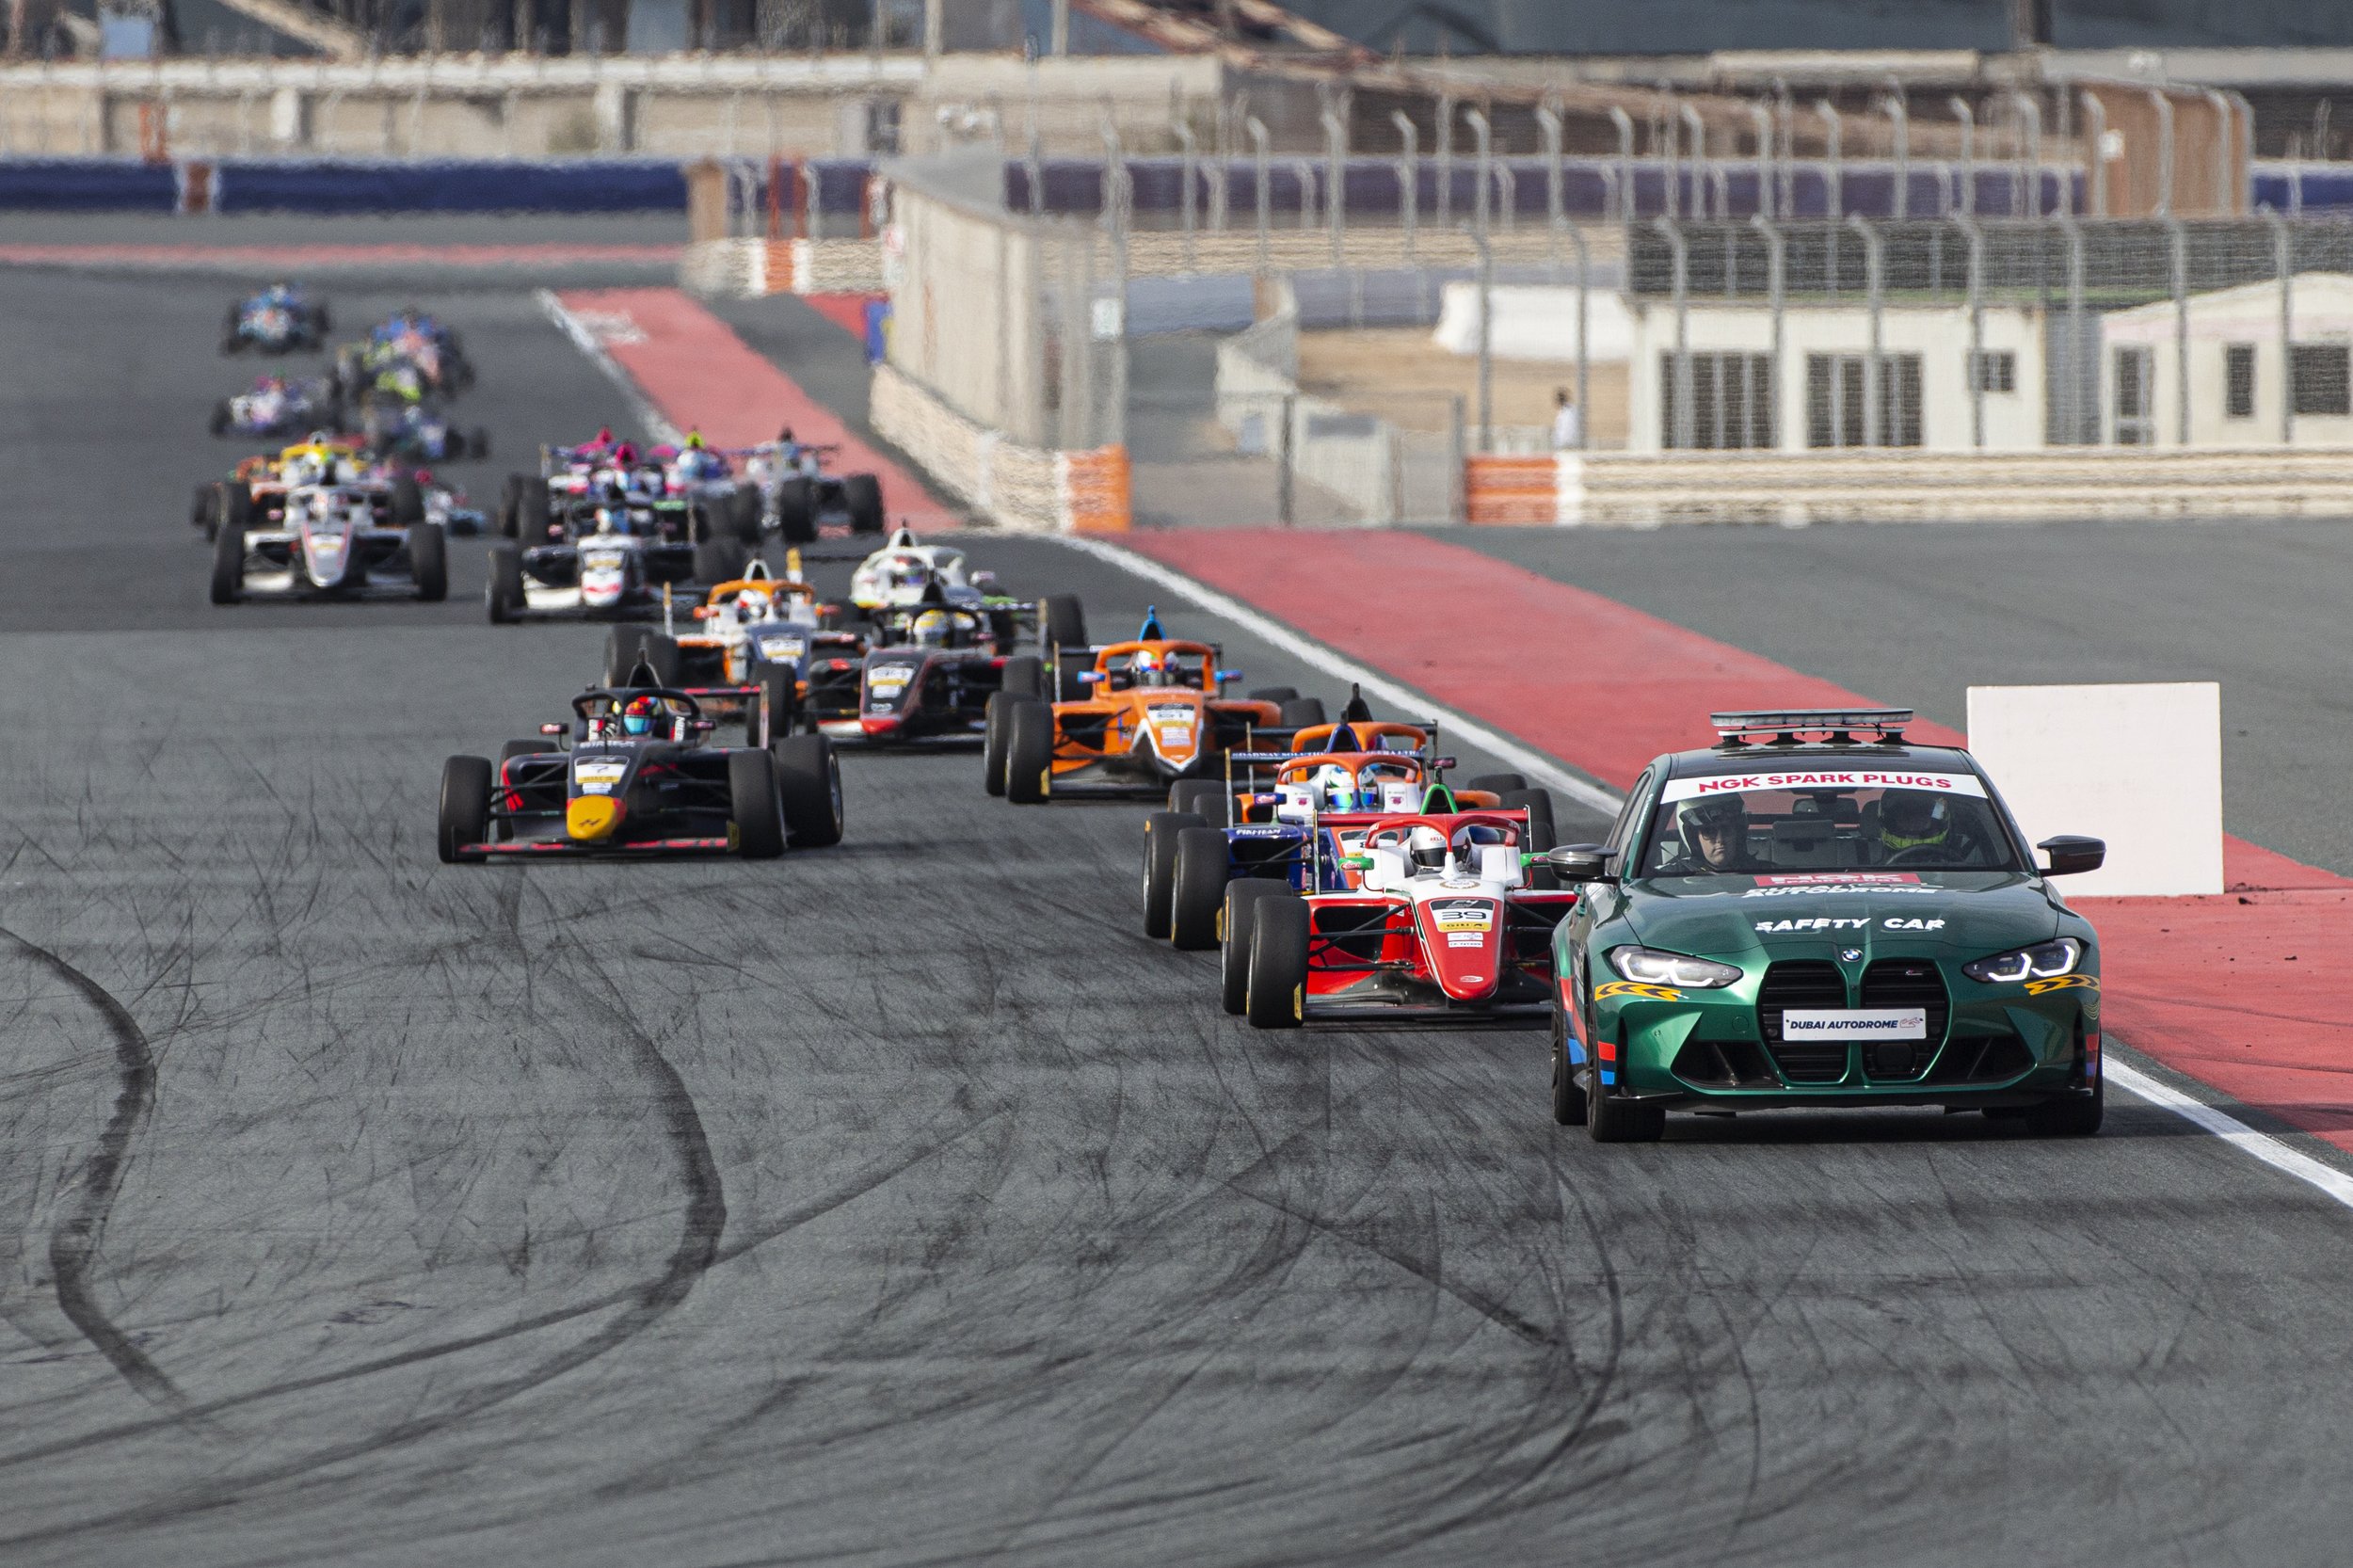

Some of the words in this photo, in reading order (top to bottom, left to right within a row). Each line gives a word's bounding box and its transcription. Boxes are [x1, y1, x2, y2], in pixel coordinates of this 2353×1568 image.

[1699, 776, 1761, 793] NGK
[1768, 774, 1856, 785] SPARK
[1863, 774, 1953, 789] PLUGS
[1441, 910, 1487, 920] 39
[1754, 918, 1872, 932] SAFETY
[1883, 918, 1945, 930] CAR
[1790, 1020, 1826, 1030] DUBAI
[1827, 1019, 1899, 1030] AUTODROME
